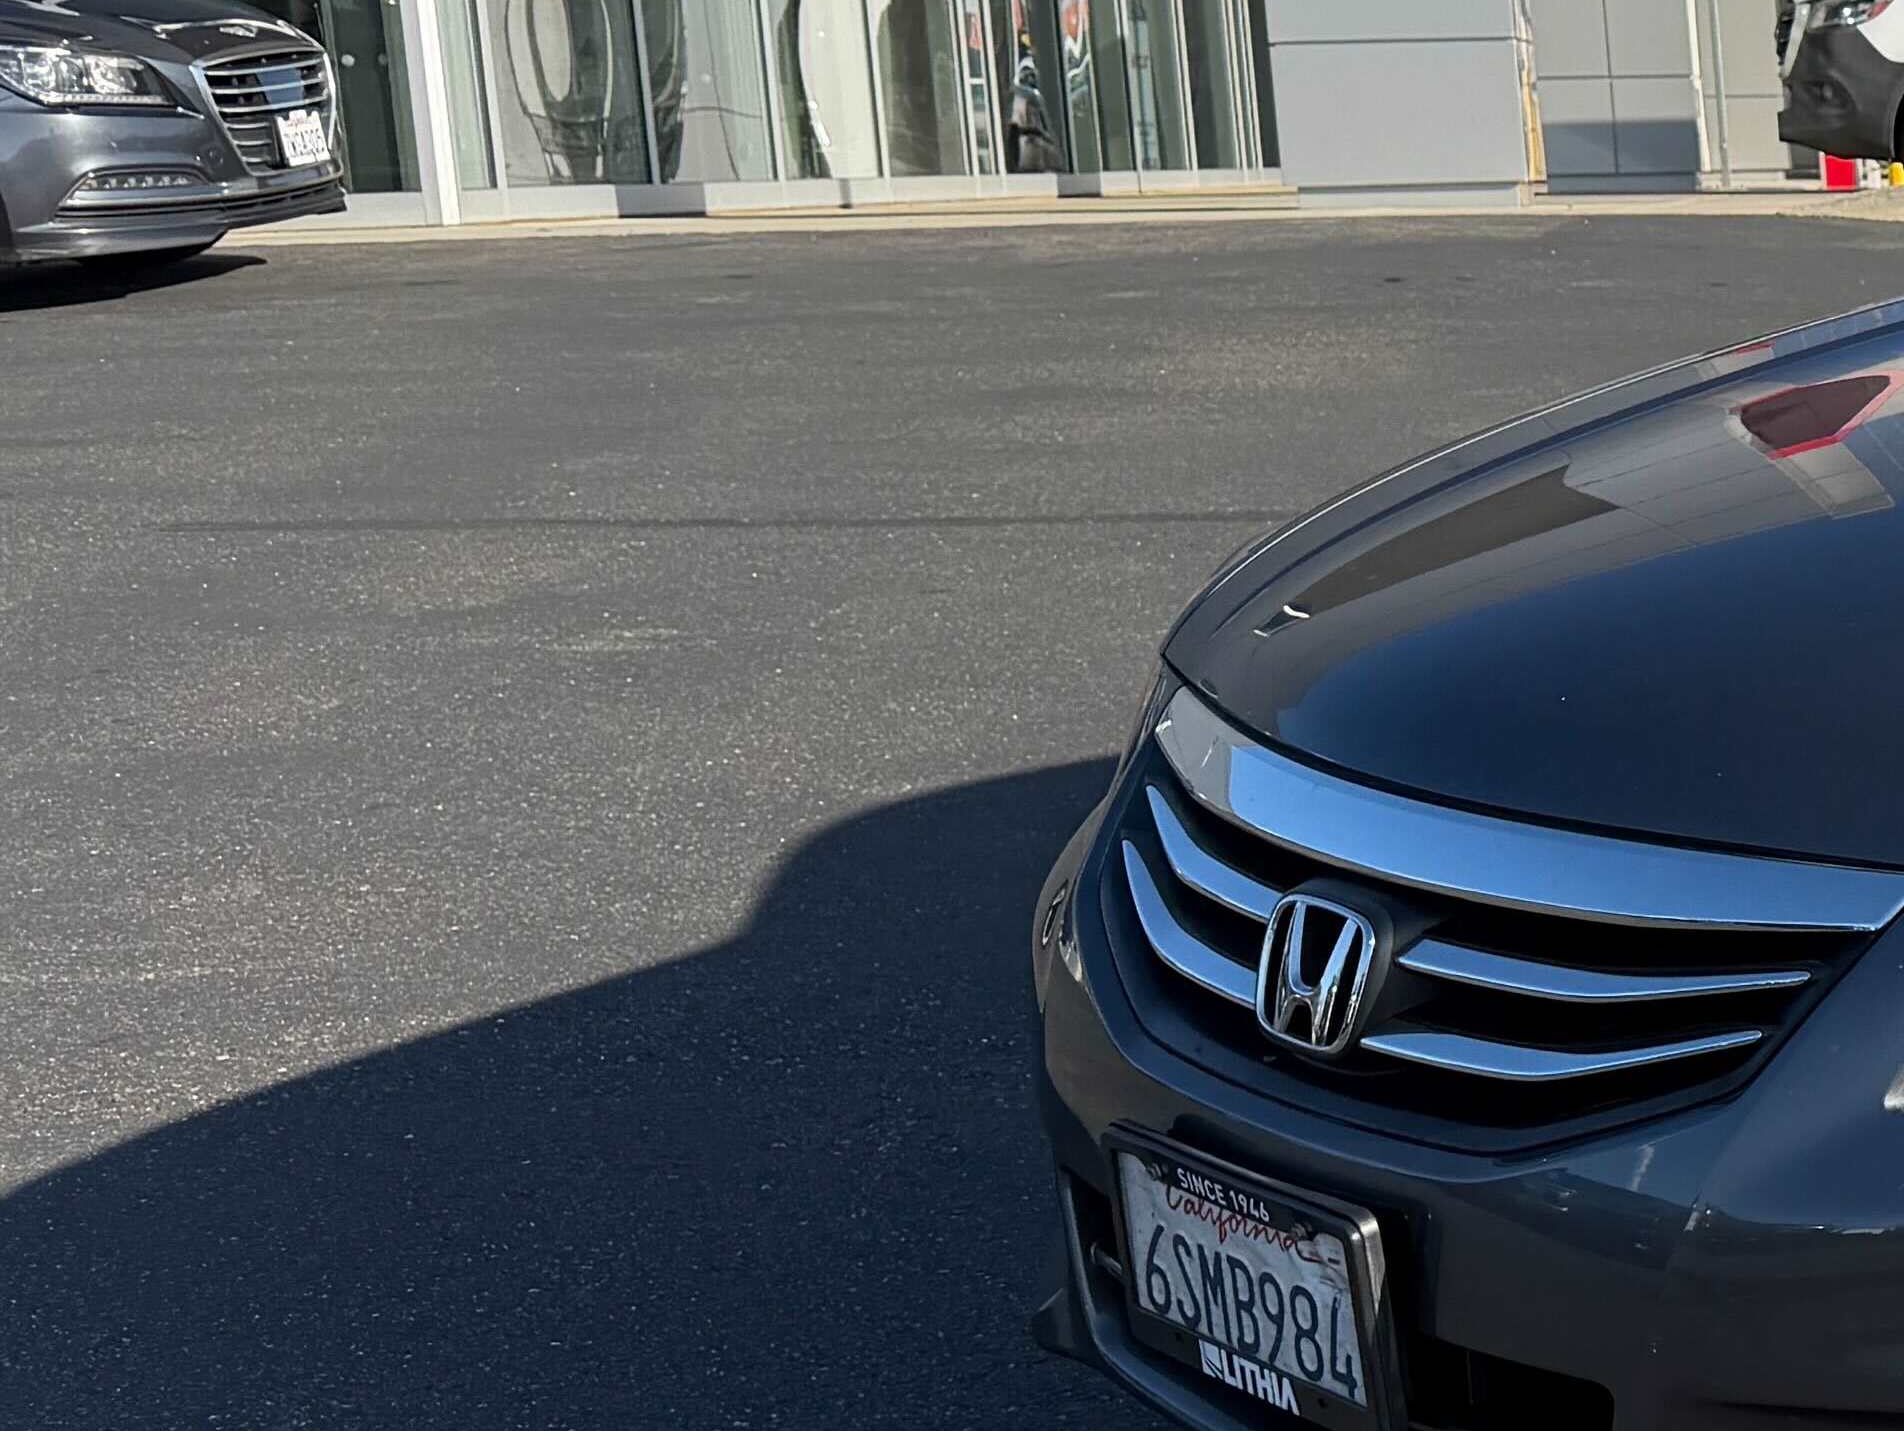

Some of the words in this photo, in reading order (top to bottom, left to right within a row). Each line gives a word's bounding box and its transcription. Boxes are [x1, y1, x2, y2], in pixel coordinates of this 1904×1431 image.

[1176, 1168, 1226, 1208] SINCE
[1229, 1189, 1270, 1223] 1946
[1145, 1223, 1359, 1400] 6SMB984
[1221, 1347, 1300, 1416] LITHIA
